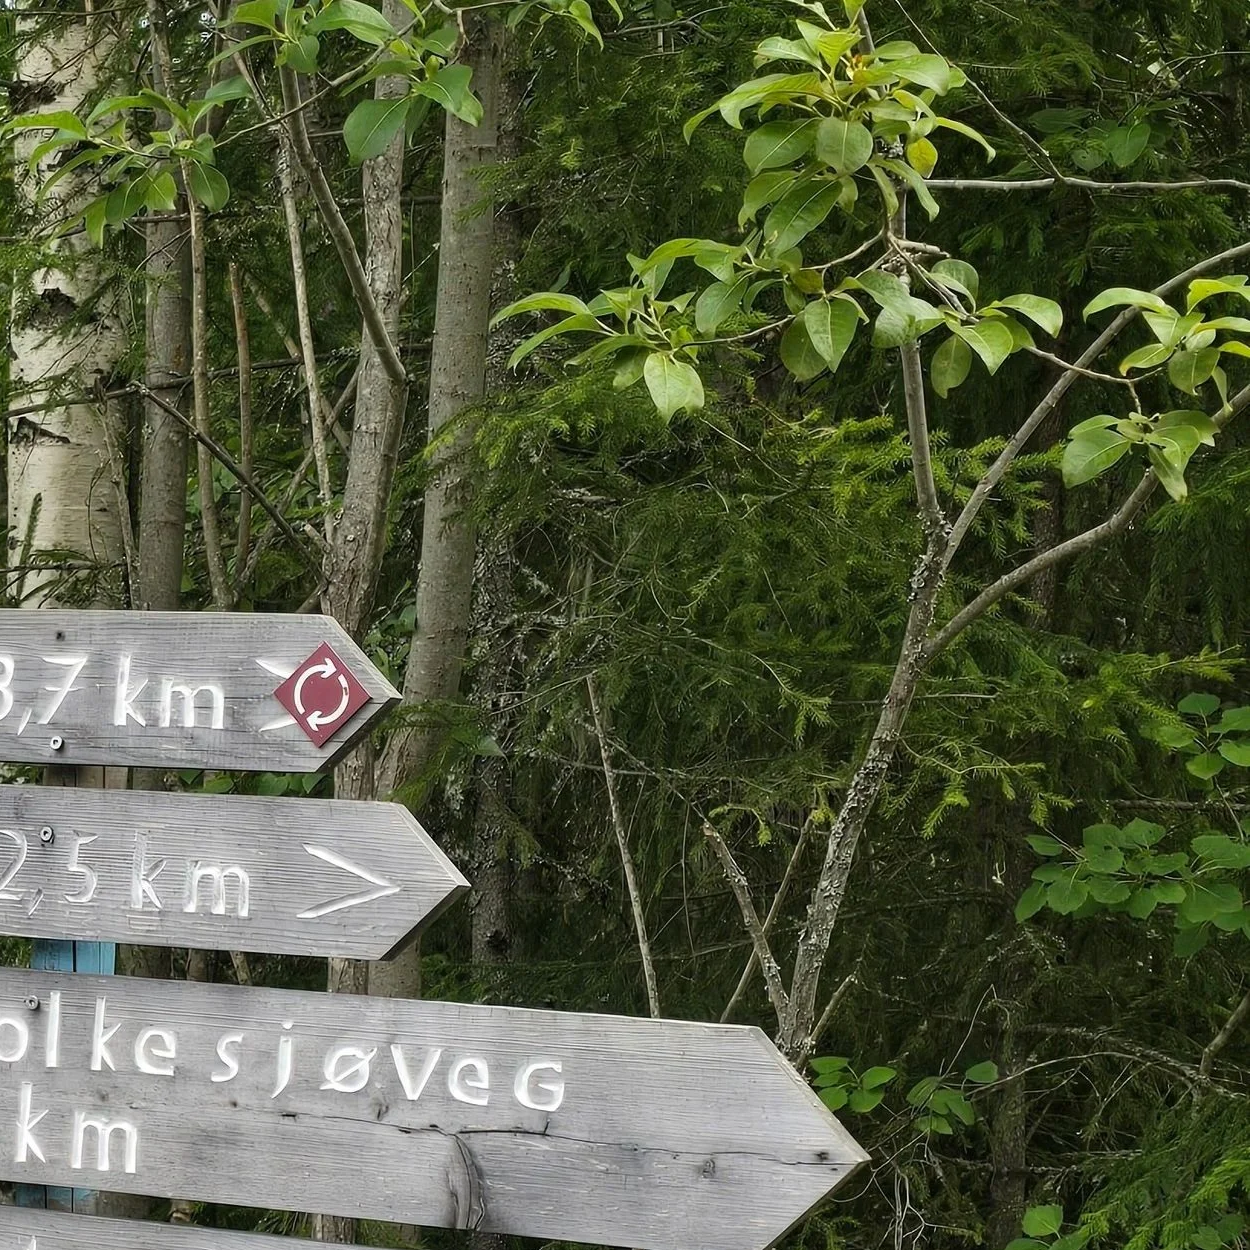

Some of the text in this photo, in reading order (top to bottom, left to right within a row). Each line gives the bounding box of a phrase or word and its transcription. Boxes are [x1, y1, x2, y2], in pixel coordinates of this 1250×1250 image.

[113, 652, 225, 730] km
[131, 830, 250, 918] km
[14, 1080, 138, 1174] km
